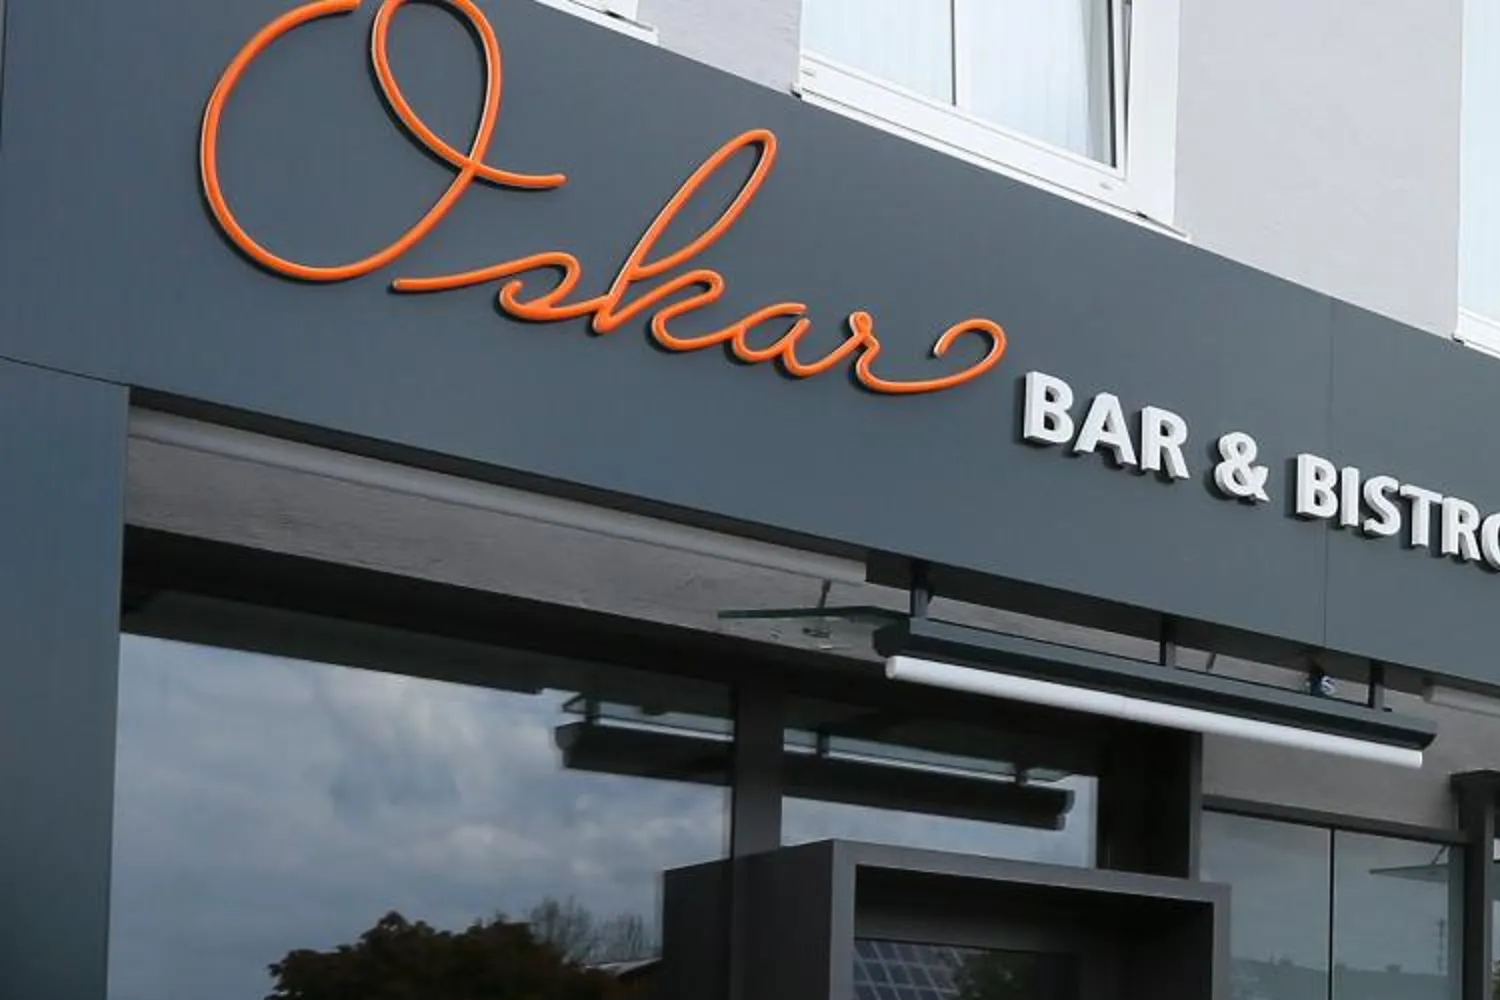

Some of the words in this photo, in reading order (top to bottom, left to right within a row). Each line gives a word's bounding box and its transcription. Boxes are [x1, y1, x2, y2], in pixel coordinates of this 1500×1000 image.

[200, 0, 1006, 394] Oskar
[1023, 371, 1190, 480] BAR
[1214, 432, 1270, 502] &
